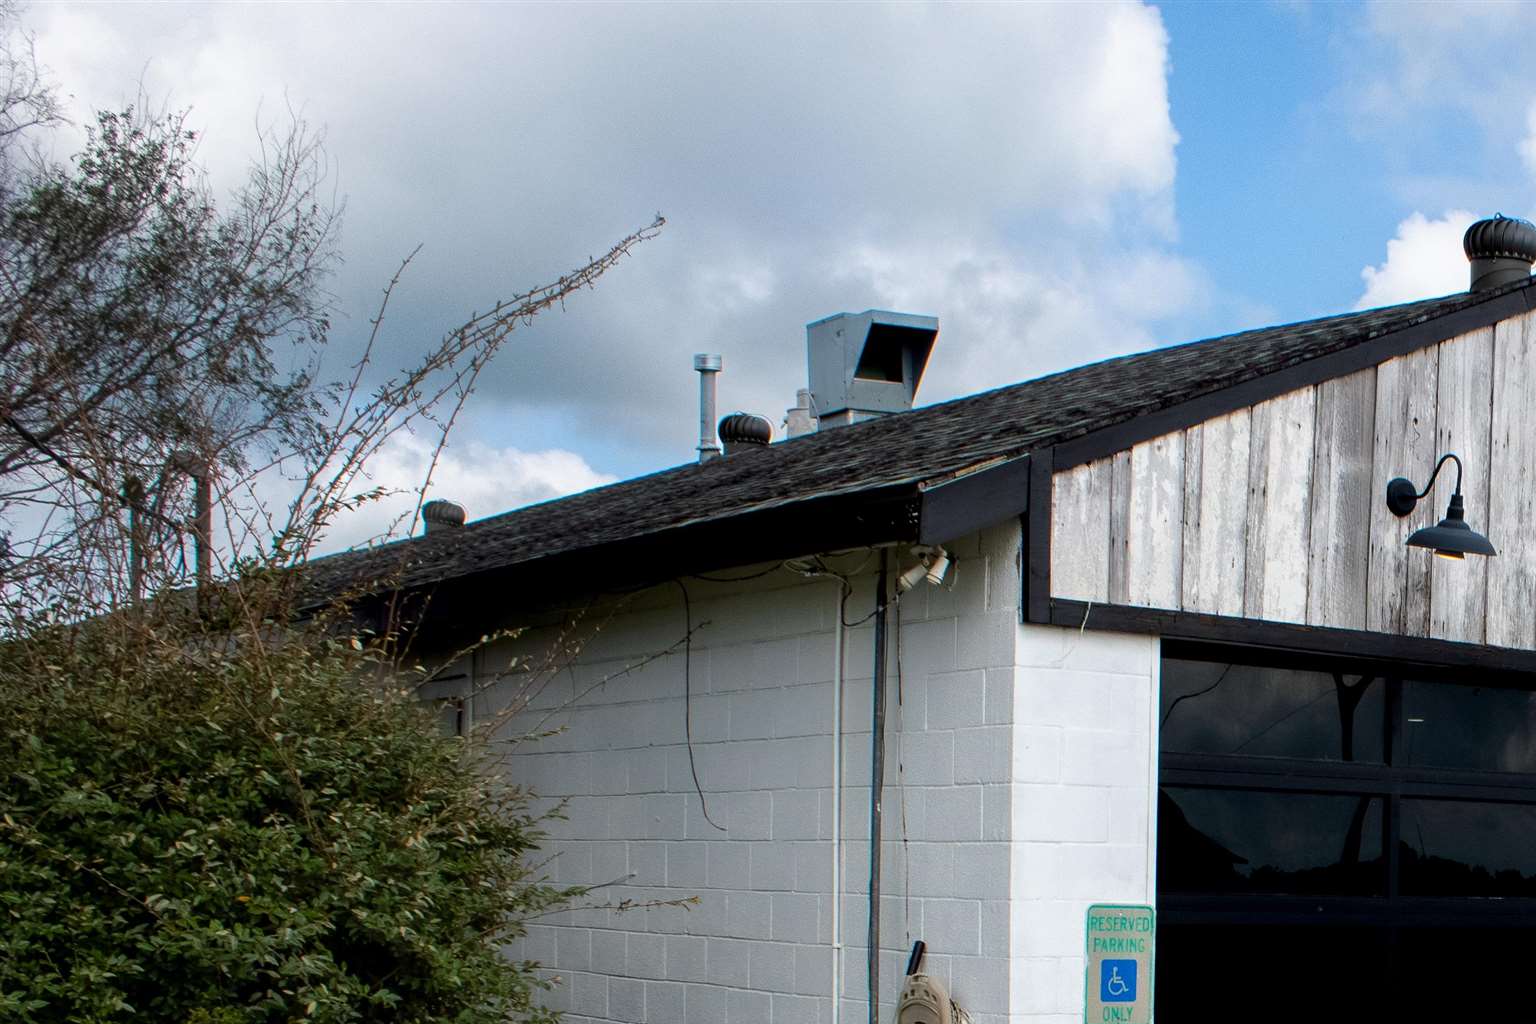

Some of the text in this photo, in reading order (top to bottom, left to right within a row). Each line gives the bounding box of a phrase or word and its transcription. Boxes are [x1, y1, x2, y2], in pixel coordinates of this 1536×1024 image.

[1090, 916, 1150, 932] RESERVED
[1094, 938, 1145, 953] PARKING
[1103, 1006, 1134, 1022] ONLY
